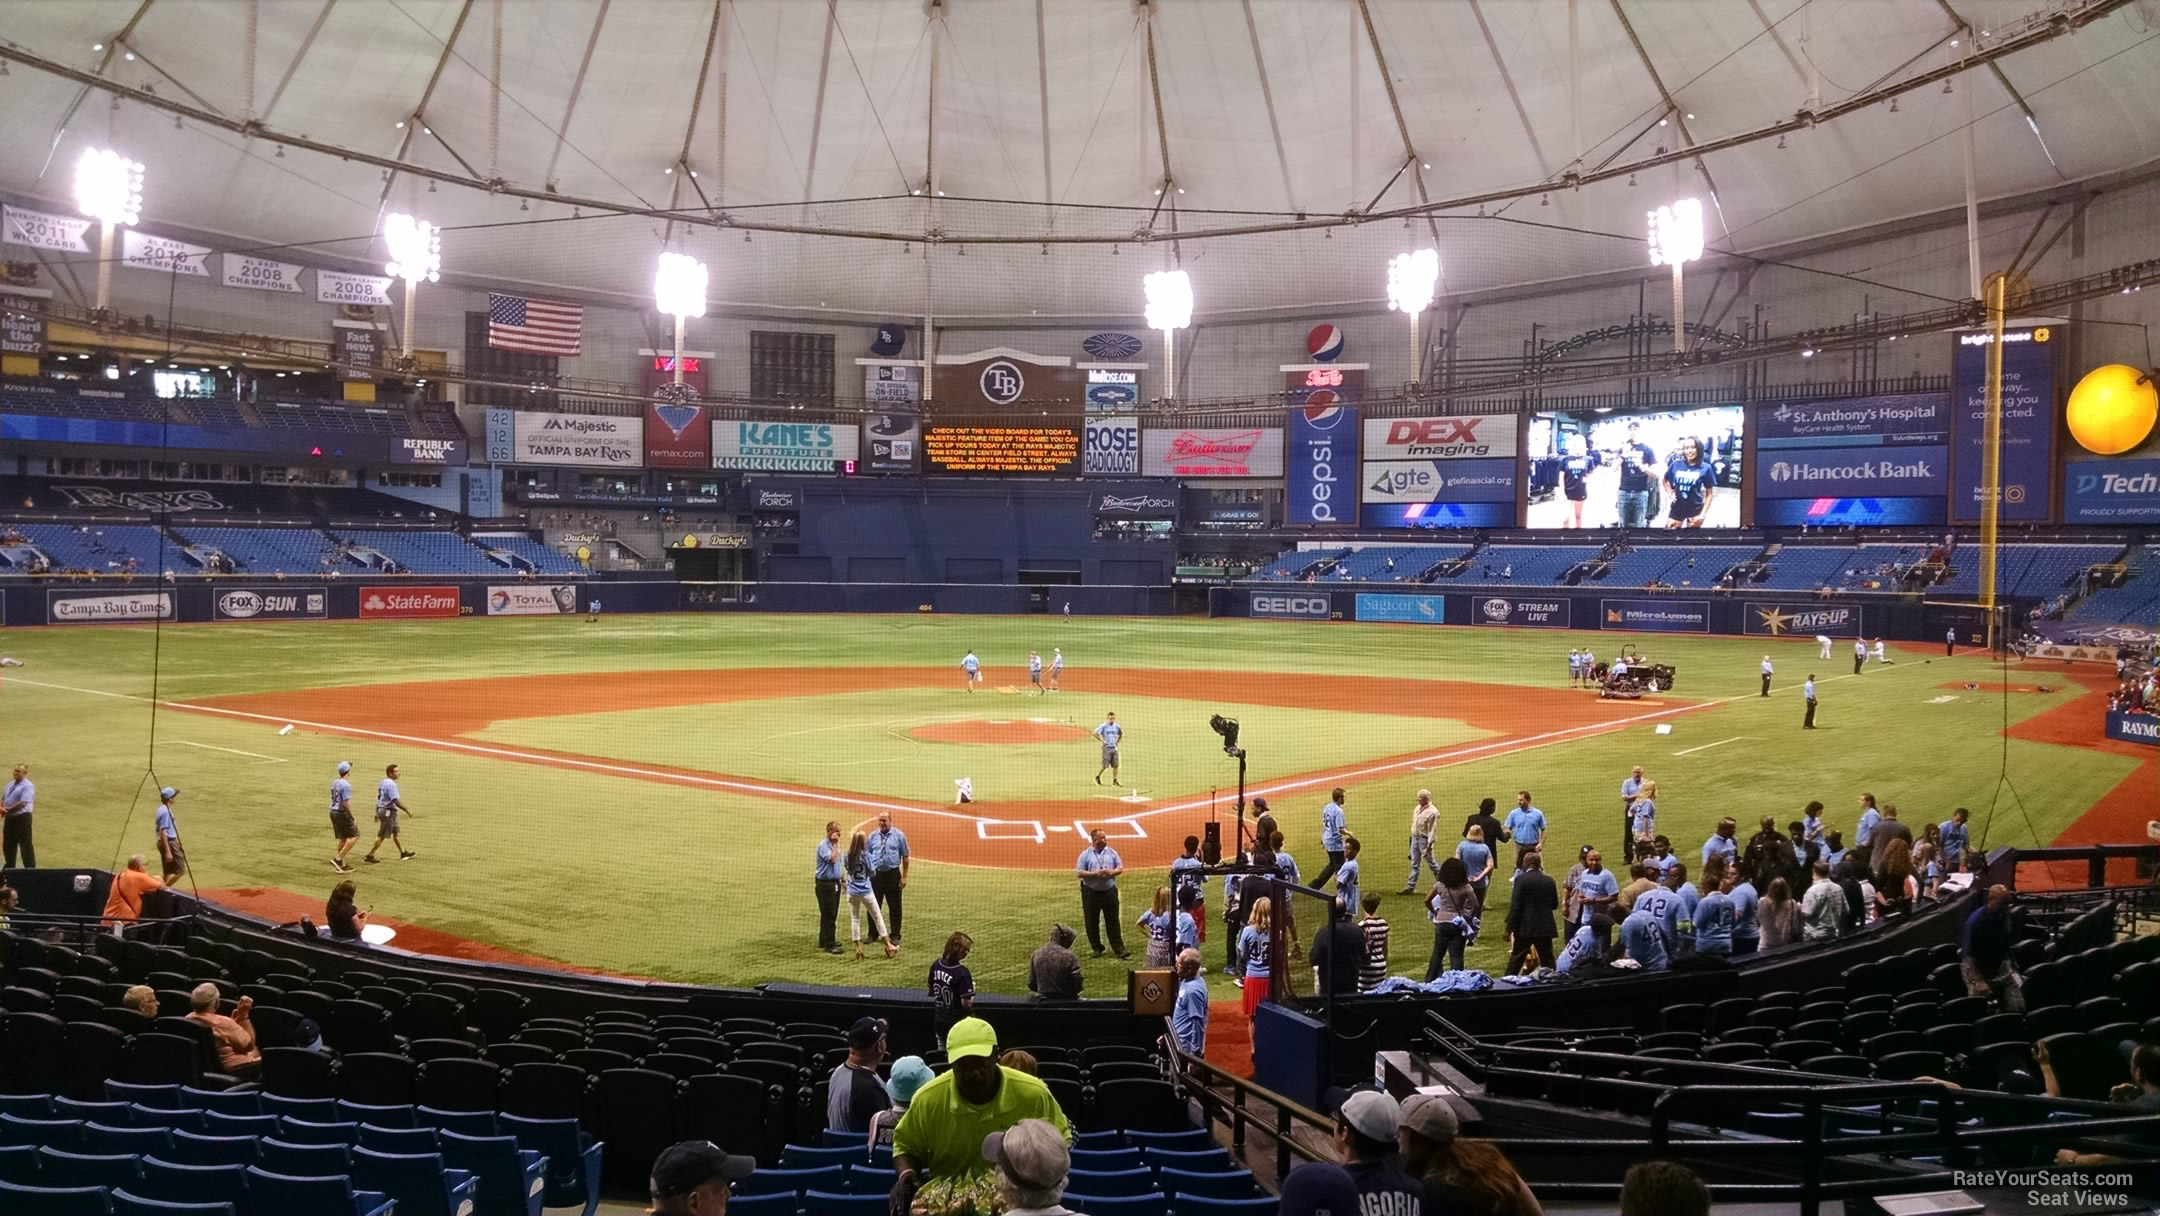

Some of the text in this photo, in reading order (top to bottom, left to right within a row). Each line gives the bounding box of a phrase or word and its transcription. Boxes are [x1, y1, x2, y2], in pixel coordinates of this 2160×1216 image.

[26, 221, 65, 239] 2011
[46, 238, 76, 249] CARD
[143, 245, 187, 263] 2010
[129, 255, 199, 273] CHAMPIONS
[258, 260, 280, 269] EAST
[241, 265, 282, 281] 2008
[228, 275, 293, 291] CHAMPIONS
[335, 281, 373, 295] 2008
[323, 291, 384, 304] CHAMPIONS
[1, 319, 40, 331] heard
[10, 330, 33, 341] the
[347, 331, 371, 343] Fast
[881, 330, 892, 343] TB
[1, 339, 41, 353] buzz?
[346, 342, 375, 352] news
[988, 369, 1017, 397] TB
[2017, 395, 2039, 406] you
[491, 412, 509, 426] 42
[1793, 404, 1935, 424] St. Anthony's Hospital
[565, 419, 617, 434] Majestic
[1386, 417, 1484, 445] DEX
[1793, 423, 1871, 434] BayCare Health System
[493, 430, 507, 443] 12
[528, 434, 563, 444] OFFICIAL
[566, 436, 602, 445] UNIFORM
[603, 438, 614, 446] OF
[740, 422, 833, 448] KANE'S
[1086, 426, 1137, 451] ROSE
[403, 438, 455, 451] REPUBLIC
[1408, 443, 1490, 457] imaging
[414, 448, 445, 459] BANK
[491, 447, 509, 460] 66
[528, 445, 571, 457] TAMPA
[575, 446, 599, 458] BAY
[650, 449, 704, 458] remax.com
[742, 447, 829, 457] FURNITURE
[845, 460, 854, 473] 0
[1086, 451, 1137, 472] RADIOLOGY
[1793, 460, 1931, 481] Hancock Bank
[1308, 439, 1337, 522] pepsi
[1395, 468, 1431, 491] gte
[1447, 475, 1512, 487] gtefinancial.org
[759, 489, 792, 499] Budweiser
[1401, 484, 1436, 497] financial
[760, 498, 792, 506] PORCH
[1103, 496, 1174, 508] Budweiser PORCH
[2080, 508, 2116, 516] PROUDLY
[563, 533, 600, 544] Ducky's
[711, 534, 747, 547] Ducky's
[60, 600, 167, 616] Tampa Bay Times
[229, 596, 297, 612] FOX SUN
[1253, 597, 1328, 614] GEICO
[1364, 596, 1413, 613] Sagicor
[1490, 602, 1506, 611] FOX
[1518, 603, 1559, 613] STREAM
[1332, 611, 1343, 619] 370
[1528, 612, 1549, 622] LIVE
[1971, 634, 1981, 643] 322
[1642, 898, 1667, 919] 42
[1641, 921, 1660, 945] 42
